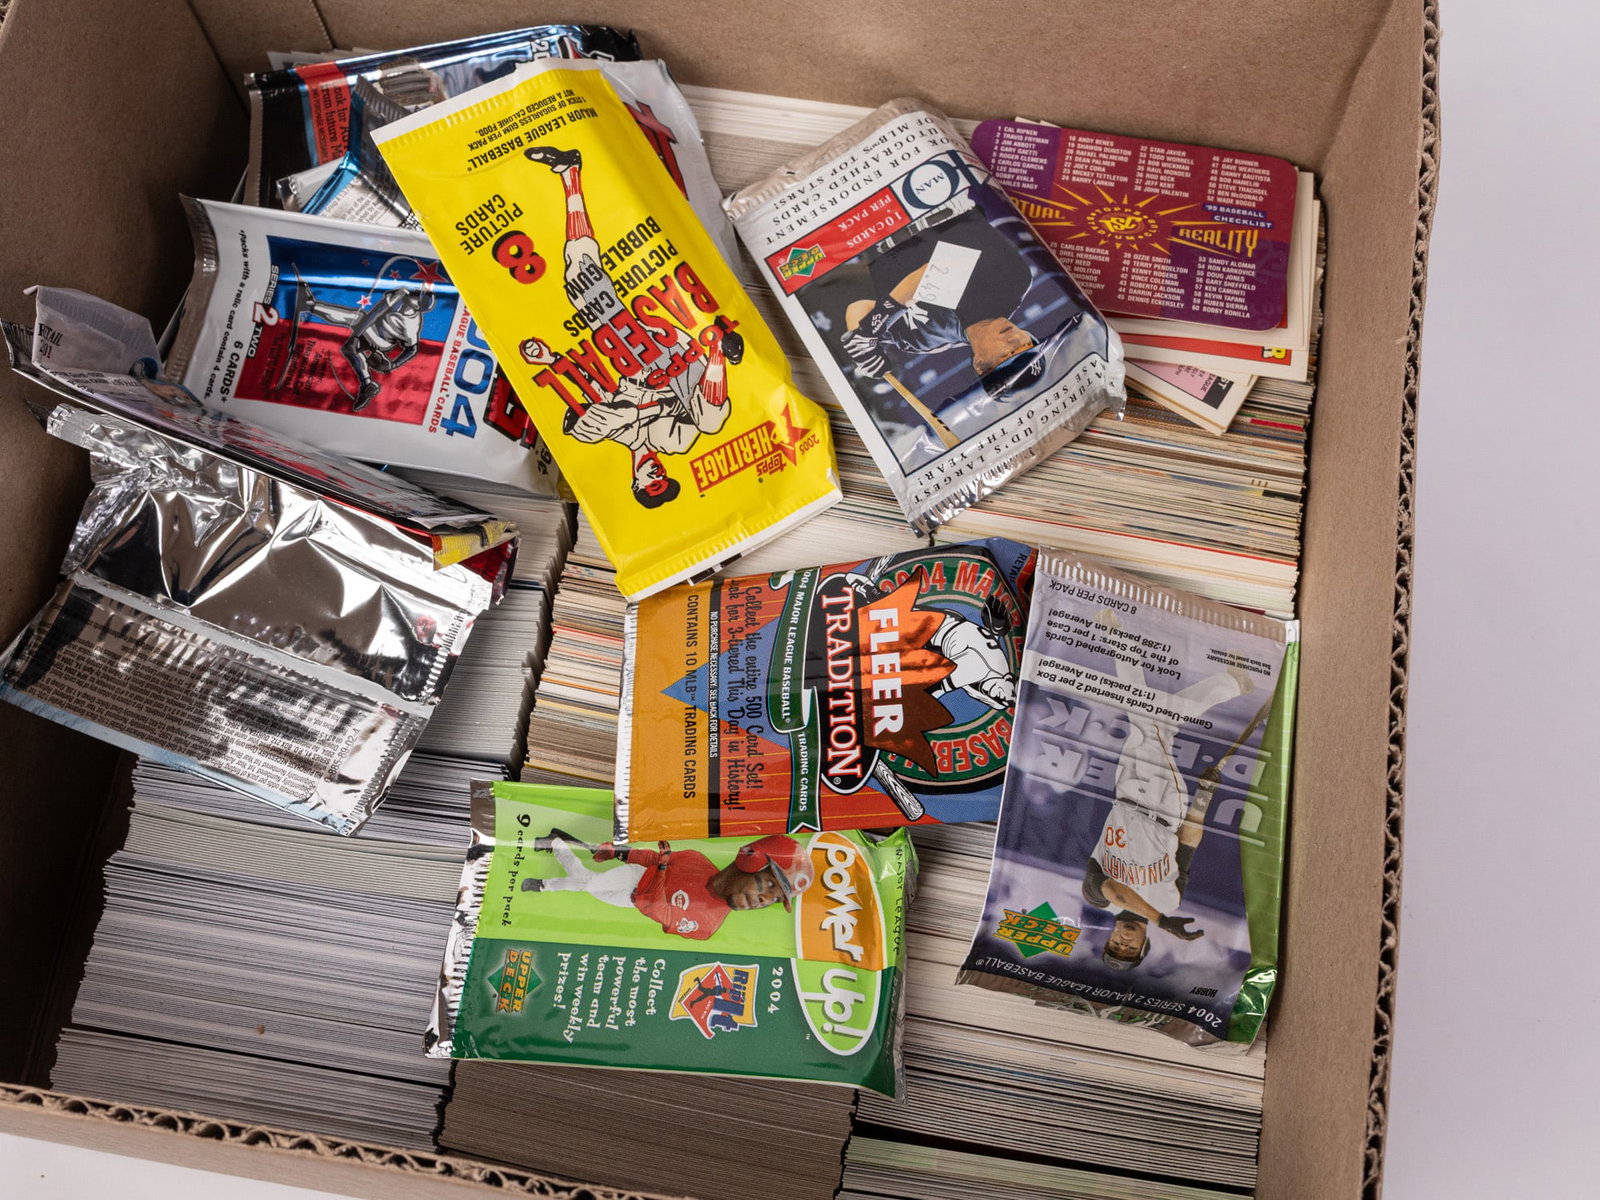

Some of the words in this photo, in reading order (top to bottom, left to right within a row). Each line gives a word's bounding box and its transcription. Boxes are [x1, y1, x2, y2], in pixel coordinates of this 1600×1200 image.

[525, 94, 556, 113] REDUCED
[496, 108, 525, 127] CALORIE
[518, 103, 556, 127] SUGARLESS
[566, 108, 598, 123] MAJOR
[475, 122, 497, 138] FOOD.
[487, 129, 502, 142] PER
[501, 121, 519, 135] GUM
[524, 115, 566, 142] LEAGUE
[467, 136, 487, 151] PACK
[828, 154, 858, 176] TOP
[889, 146, 920, 168] FOR
[1091, 158, 1115, 166] PALMER
[772, 175, 824, 210] STARS!
[914, 172, 945, 194] MAN
[1237, 186, 1267, 195] TRACHSEL
[763, 169, 881, 245] ENDORSEMENT
[771, 191, 821, 225] CARDS
[868, 193, 891, 212] PER
[1219, 206, 1264, 217] BASEBALL
[454, 193, 506, 236] CARDS
[836, 207, 868, 232] PACK
[1214, 215, 1272, 228] CHECKLIST
[459, 202, 523, 255] PICTURE
[845, 220, 885, 248] CARDS
[599, 215, 661, 271] BUBBLE
[1179, 227, 1258, 257] REALITY
[492, 231, 545, 284] 8
[611, 238, 677, 298] PICTURE
[782, 251, 823, 278] UPPER
[1151, 256, 1171, 264] SMITH
[1208, 257, 1228, 265] SANDY
[1229, 260, 1256, 269] ALOMAR
[562, 262, 603, 300] GUM
[1131, 267, 1151, 275] KENNY
[1153, 270, 1177, 279] ROGERS
[1150, 277, 1179, 286] COLEMAN
[1206, 271, 1224, 279] DOUG
[1225, 274, 1244, 282] JONES
[1222, 266, 1255, 276] KARKOVICE
[263, 264, 278, 304] SERIES
[1205, 278, 1222, 286] GARY
[1223, 280, 1256, 290] SHEFFIELD
[1217, 287, 1245, 296] CAMINITI
[1127, 295, 1149, 303] DENNIS
[1150, 299, 1184, 308] ECKERSLEY
[1204, 292, 1222, 300] KEVIN
[1223, 295, 1245, 303] TAPANI
[1225, 302, 1248, 310] SIERRA
[225, 309, 235, 329] card
[251, 302, 279, 327] 2
[561, 289, 615, 338] CARDS
[1224, 309, 1250, 318] BONILLA
[215, 331, 229, 363] contain
[233, 340, 243, 349] 6
[247, 325, 262, 358] TWO
[531, 260, 720, 416] BASEBALL
[644, 314, 739, 389] TOPPS
[1041, 384, 1069, 407] SET
[428, 394, 446, 433] CARDS
[1014, 408, 1035, 426] OF
[797, 433, 819, 454] 2005
[692, 425, 772, 488] HERITAGE
[911, 454, 985, 504] LARGEST
[915, 451, 967, 486] YEAR!
[1048, 578, 1075, 595] PACK
[1076, 588, 1095, 601] PER
[725, 604, 743, 621] for
[744, 586, 760, 628] Collect
[789, 591, 804, 623] MAJOR
[1096, 594, 1129, 612] CARDS
[687, 594, 697, 647] CONTAINS
[1046, 619, 1070, 632] Case
[1047, 608, 1092, 628] Average!
[1094, 622, 1107, 632] on
[709, 620, 717, 651] PURCHASE
[745, 631, 762, 651] the
[1044, 630, 1074, 646] Cards
[1072, 626, 1089, 638] per
[1098, 635, 1127, 651] Stars:
[1108, 626, 1141, 642] packs)
[727, 626, 744, 673] 3-tiered
[784, 626, 796, 664] LEAGUE
[1074, 640, 1139, 666] Autographed
[1129, 644, 1147, 658] Top
[1141, 637, 1171, 652] (1:288
[686, 651, 697, 666] 10
[1140, 661, 1154, 671] for
[1150, 651, 1166, 663] the
[1167, 656, 1178, 666] of
[746, 655, 760, 690] entire
[868, 607, 904, 737] FLEER
[1036, 669, 1056, 682] Box
[1037, 658, 1083, 679] Average!
[1084, 672, 1097, 681] on
[1156, 665, 1180, 679] Look
[727, 677, 744, 701] This
[1083, 683, 1124, 704] Inserted
[1099, 675, 1131, 692] packs)
[1131, 687, 1155, 701] (1:12
[709, 701, 717, 718] BACK
[745, 695, 762, 718] 500
[1125, 696, 1153, 714] Cards
[709, 719, 717, 731] FOR
[723, 706, 743, 734] Day
[1154, 706, 1212, 730] Game-Used
[684, 704, 696, 755] TRADING
[709, 733, 717, 757] DETAILS
[745, 725, 762, 757] Card
[797, 732, 807, 774] TRADING
[684, 759, 696, 798] CARDS
[724, 758, 745, 811] History!
[746, 762, 763, 790] Set!
[1104, 826, 1126, 847] 30
[513, 830, 524, 866] cards
[508, 870, 520, 891] per
[501, 896, 512, 926] pack
[995, 925, 1072, 955] UPPER
[576, 953, 588, 981] win
[593, 954, 608, 994] team
[631, 956, 647, 982] the
[512, 951, 531, 1011] UPPER
[553, 952, 571, 1009] prizes!
[645, 958, 665, 1016] Collect
[767, 966, 783, 1014] 2004
[1044, 974, 1092, 993] LEAGUE
[1189, 985, 1217, 997] HOBBY
[604, 956, 626, 1030] powerful
[1092, 986, 1135, 1001] MAJOR
[1144, 996, 1185, 1011] SERIES
[562, 985, 583, 1043] weekly
[585, 998, 600, 1027] and
[624, 986, 638, 1026] most
[1187, 1005, 1221, 1027] 2004
